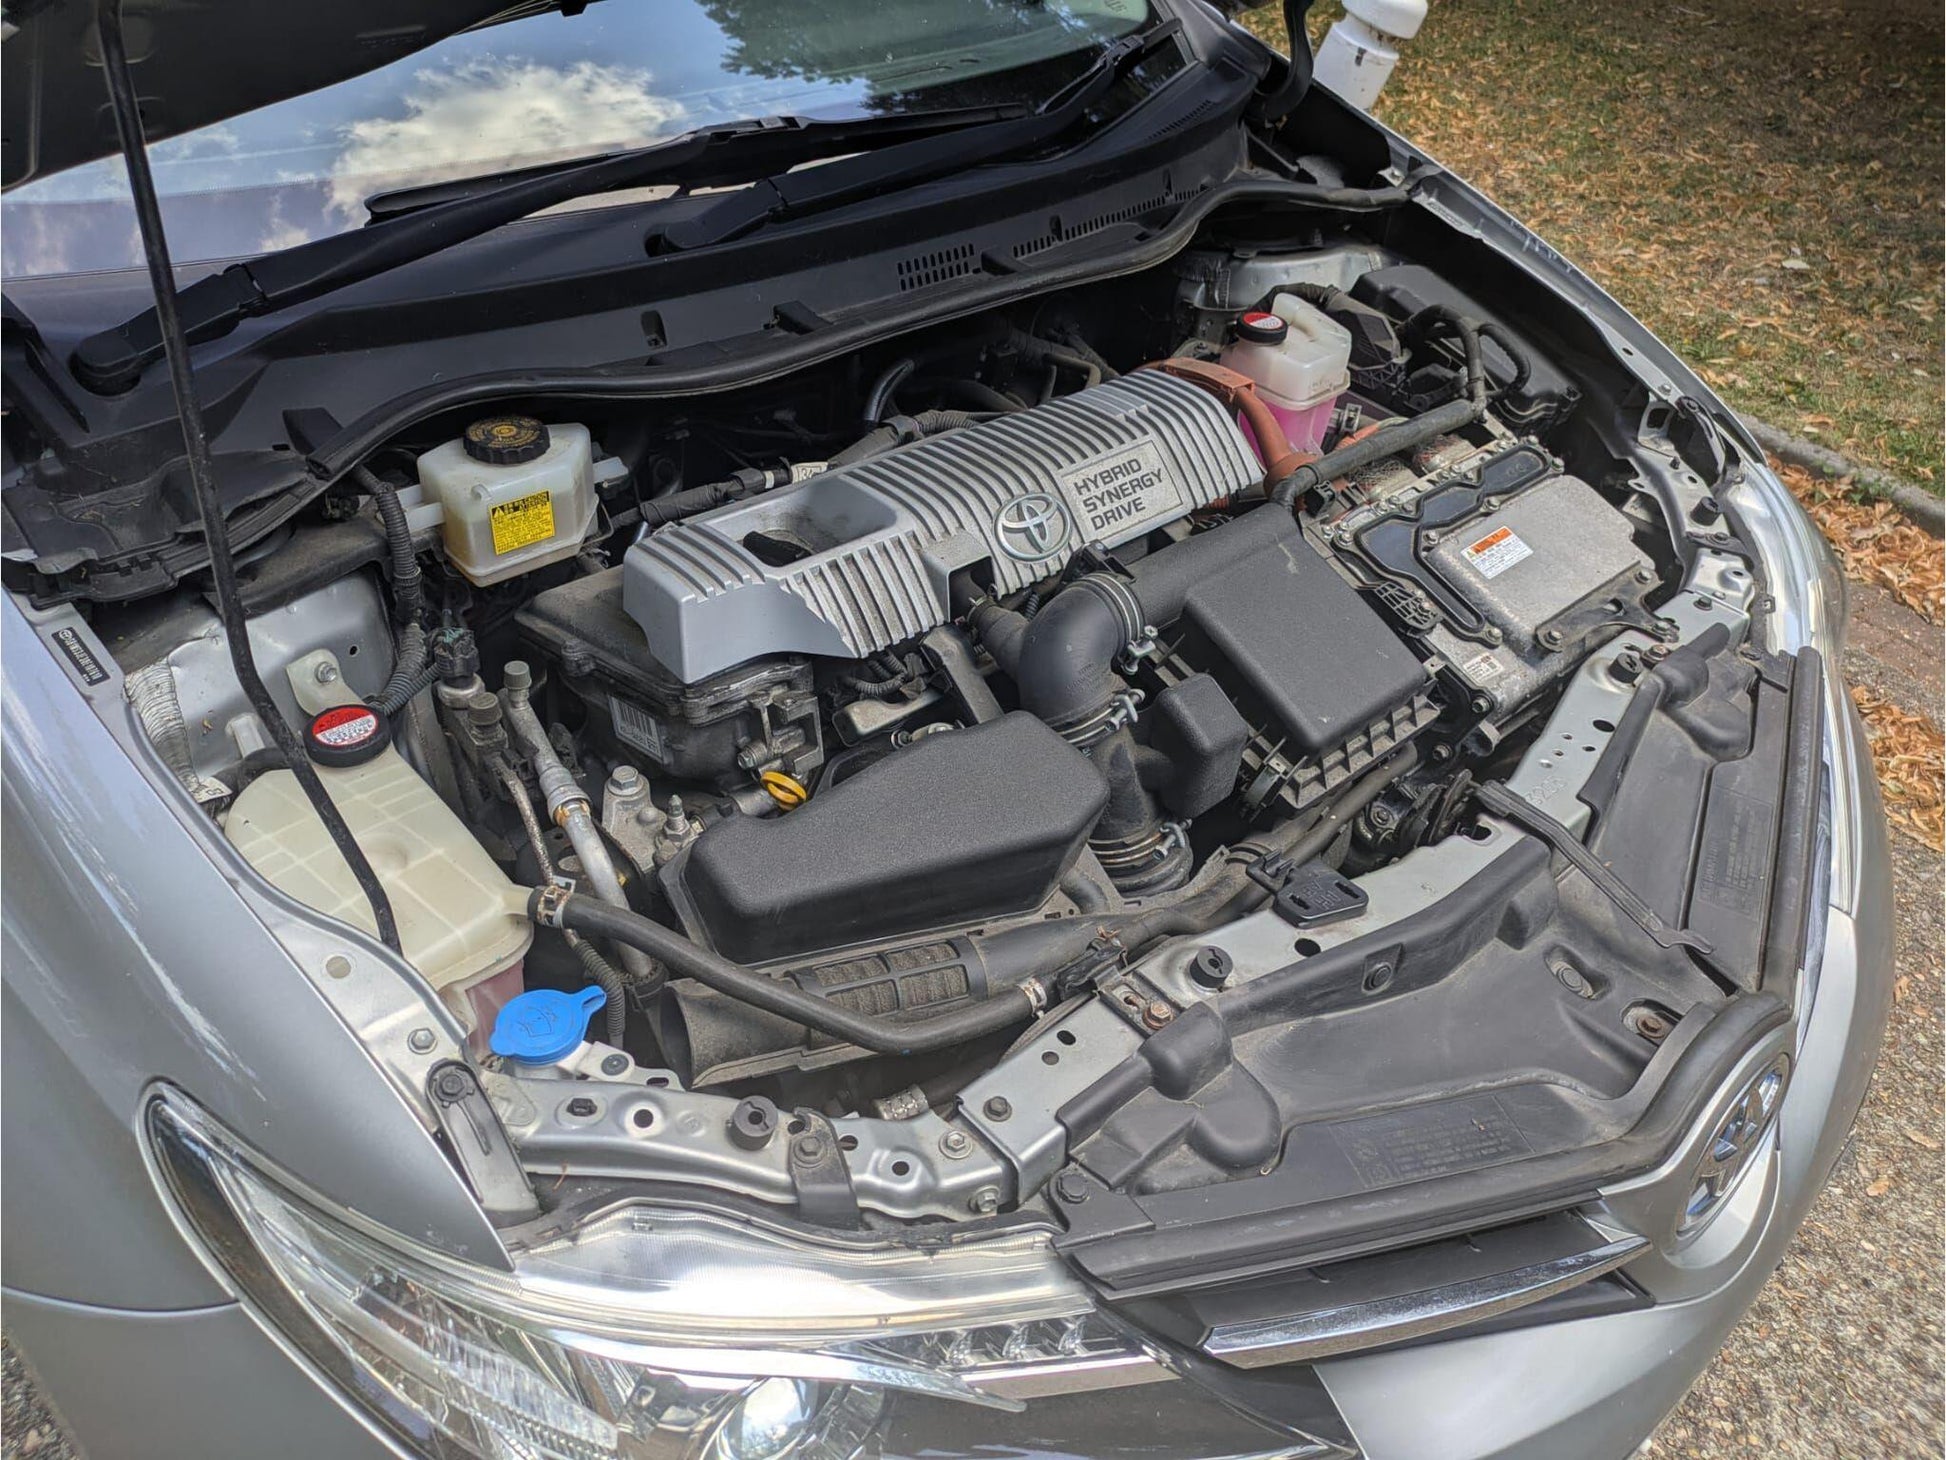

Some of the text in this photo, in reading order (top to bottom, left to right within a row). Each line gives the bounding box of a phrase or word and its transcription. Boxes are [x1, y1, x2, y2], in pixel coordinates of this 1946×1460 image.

[1073, 459, 1141, 495] HYBRID
[1082, 468, 1162, 513] SYNERGY
[1090, 497, 1146, 531] DRIVE
